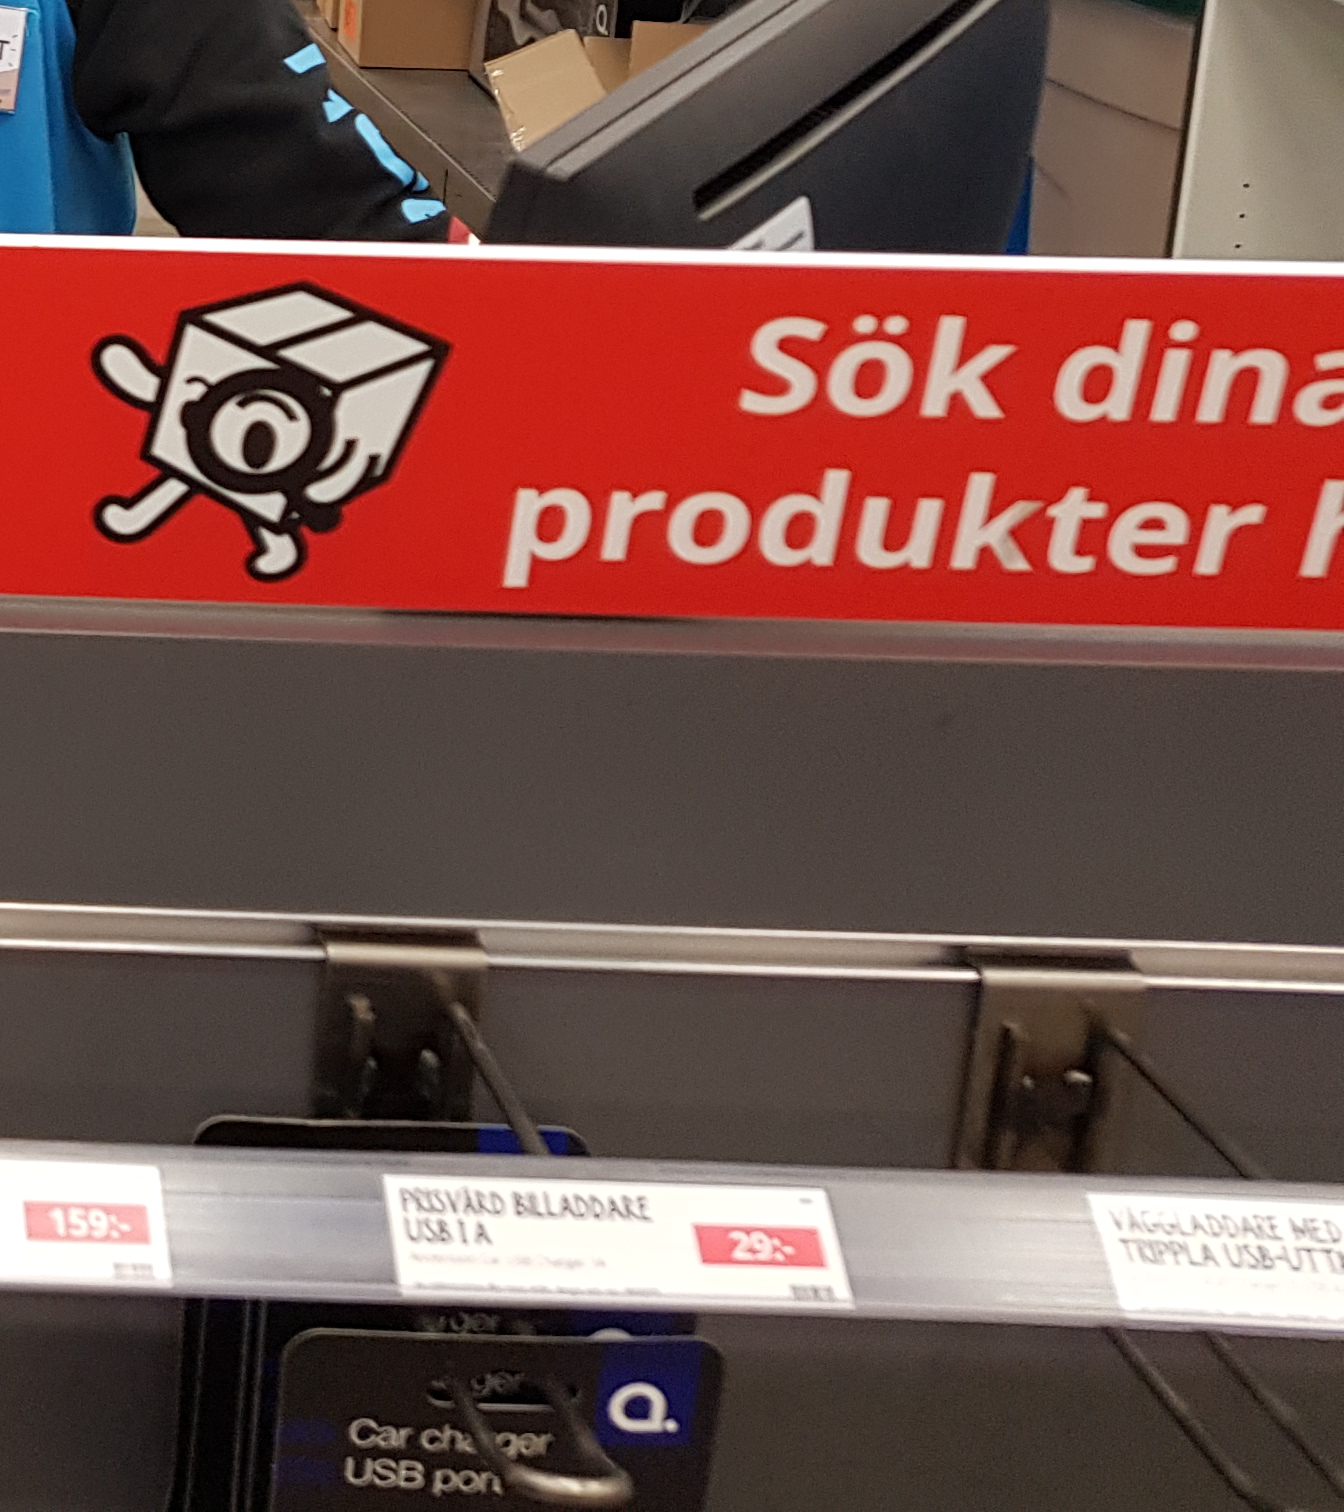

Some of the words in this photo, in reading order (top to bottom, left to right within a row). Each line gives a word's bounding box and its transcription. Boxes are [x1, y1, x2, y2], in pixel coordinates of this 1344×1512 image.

[738, 314, 1016, 419] Sök
[1053, 318, 1344, 427] dina
[502, 468, 1267, 588] produkter
[513, 1191, 653, 1222] BILLADDARE
[48, 1207, 131, 1240] 159:-
[729, 1230, 796, 1262] 29:-
[1121, 1238, 1216, 1269] TRIPPLA
[348, 1417, 414, 1451] Car
[344, 1455, 425, 1489] USB
